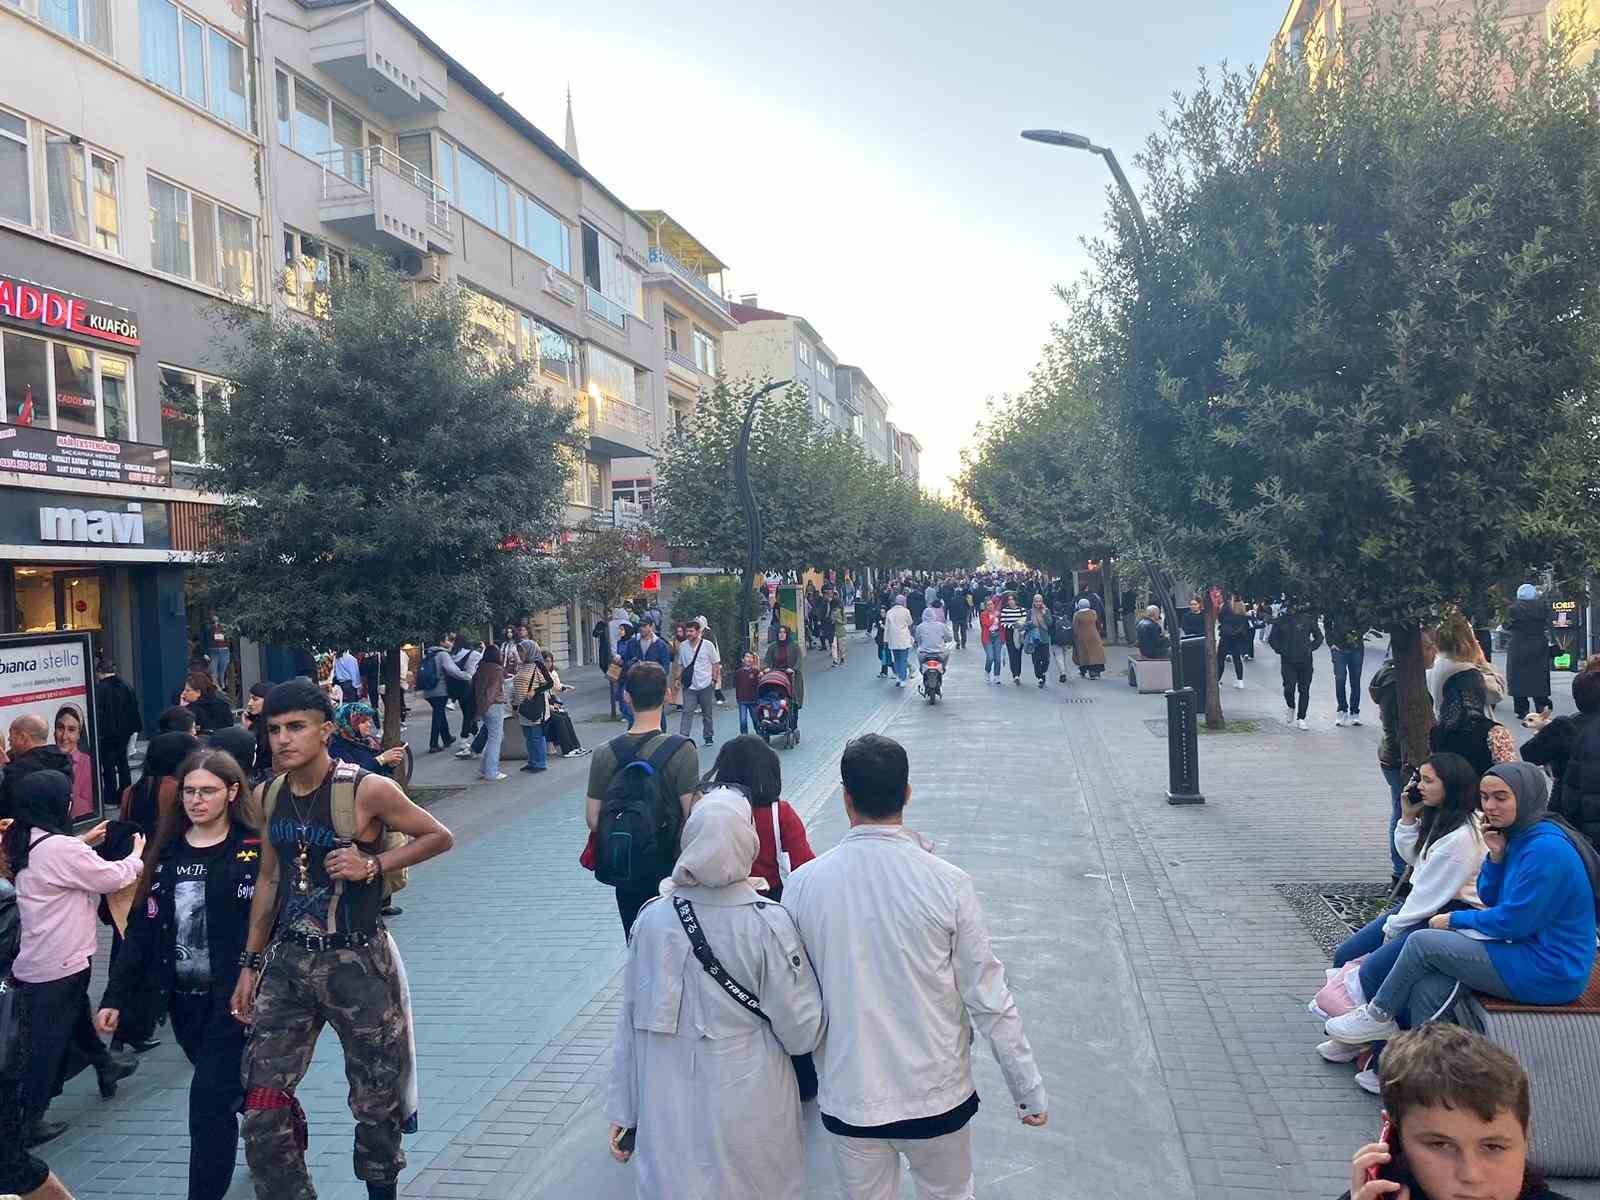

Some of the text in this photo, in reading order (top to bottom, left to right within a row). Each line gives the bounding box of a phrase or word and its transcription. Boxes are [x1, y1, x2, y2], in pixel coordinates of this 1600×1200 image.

[90, 314, 138, 338] KUAFÖR
[39, 502, 144, 544] mavi
[0, 649, 79, 675] bianca stella
[724, 979, 750, 1002] TAKE
